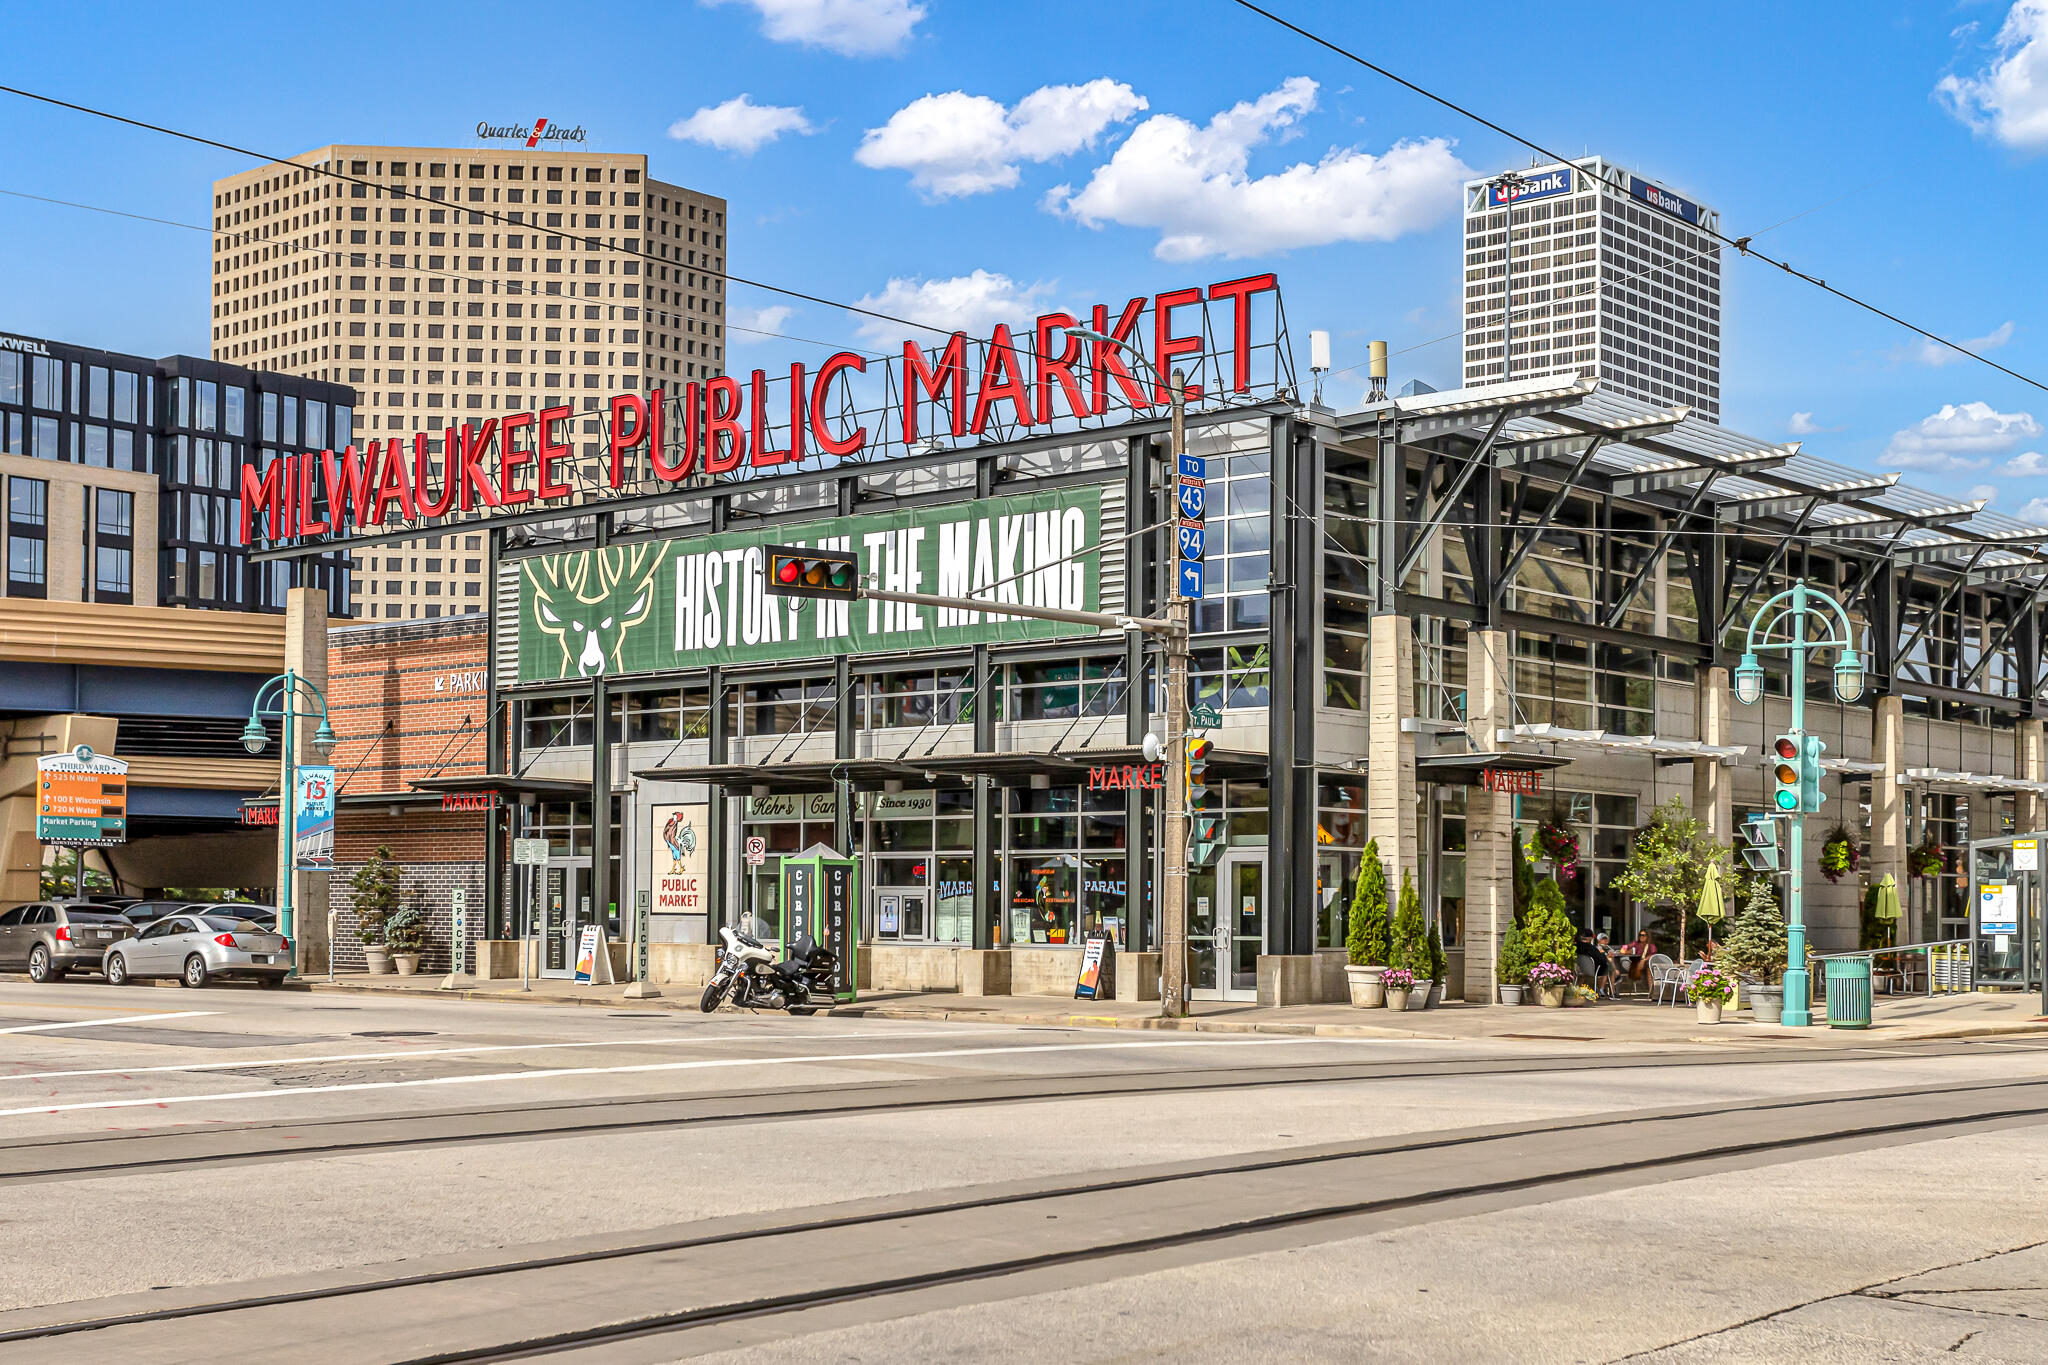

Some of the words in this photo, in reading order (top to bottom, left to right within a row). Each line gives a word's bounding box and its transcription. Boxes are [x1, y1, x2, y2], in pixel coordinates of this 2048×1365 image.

[476, 121, 529, 139] Quarles
[543, 123, 587, 142] Brady
[240, 404, 574, 546] MILWAUKEE
[609, 351, 867, 490] PUBLIC
[902, 272, 1278, 445] MARKET
[1185, 459, 1199, 473] TO
[1182, 478, 1202, 487] INTERSTATE
[1182, 486, 1202, 511] 43
[1182, 519, 1202, 529] INTERSTATE
[1180, 528, 1201, 553] 94
[863, 526, 925, 635] THE
[937, 506, 1087, 628] MAKING
[1200, 715, 1216, 727] PAUL
[60, 762, 84, 770] THIRD
[1089, 763, 1162, 791] MARKE
[1484, 768, 1543, 797] MARKET
[306, 781, 326, 799] 15
[75, 797, 111, 805] Wisconsin
[442, 790, 499, 812] MARKET
[752, 795, 794, 816] Kehr's
[880, 798, 906, 809] Since
[908, 798, 932, 810] 1930
[69, 819, 97, 827] Parking
[248, 807, 279, 825] MARK
[912, 866, 926, 875] OPE
[662, 878, 697, 892] PUBLIC
[456, 892, 462, 901] 2
[659, 894, 699, 907] MARKET
[795, 870, 803, 942] CURBS
[834, 870, 842, 988] CURBSIDE
[455, 907, 463, 972] PCKUP
